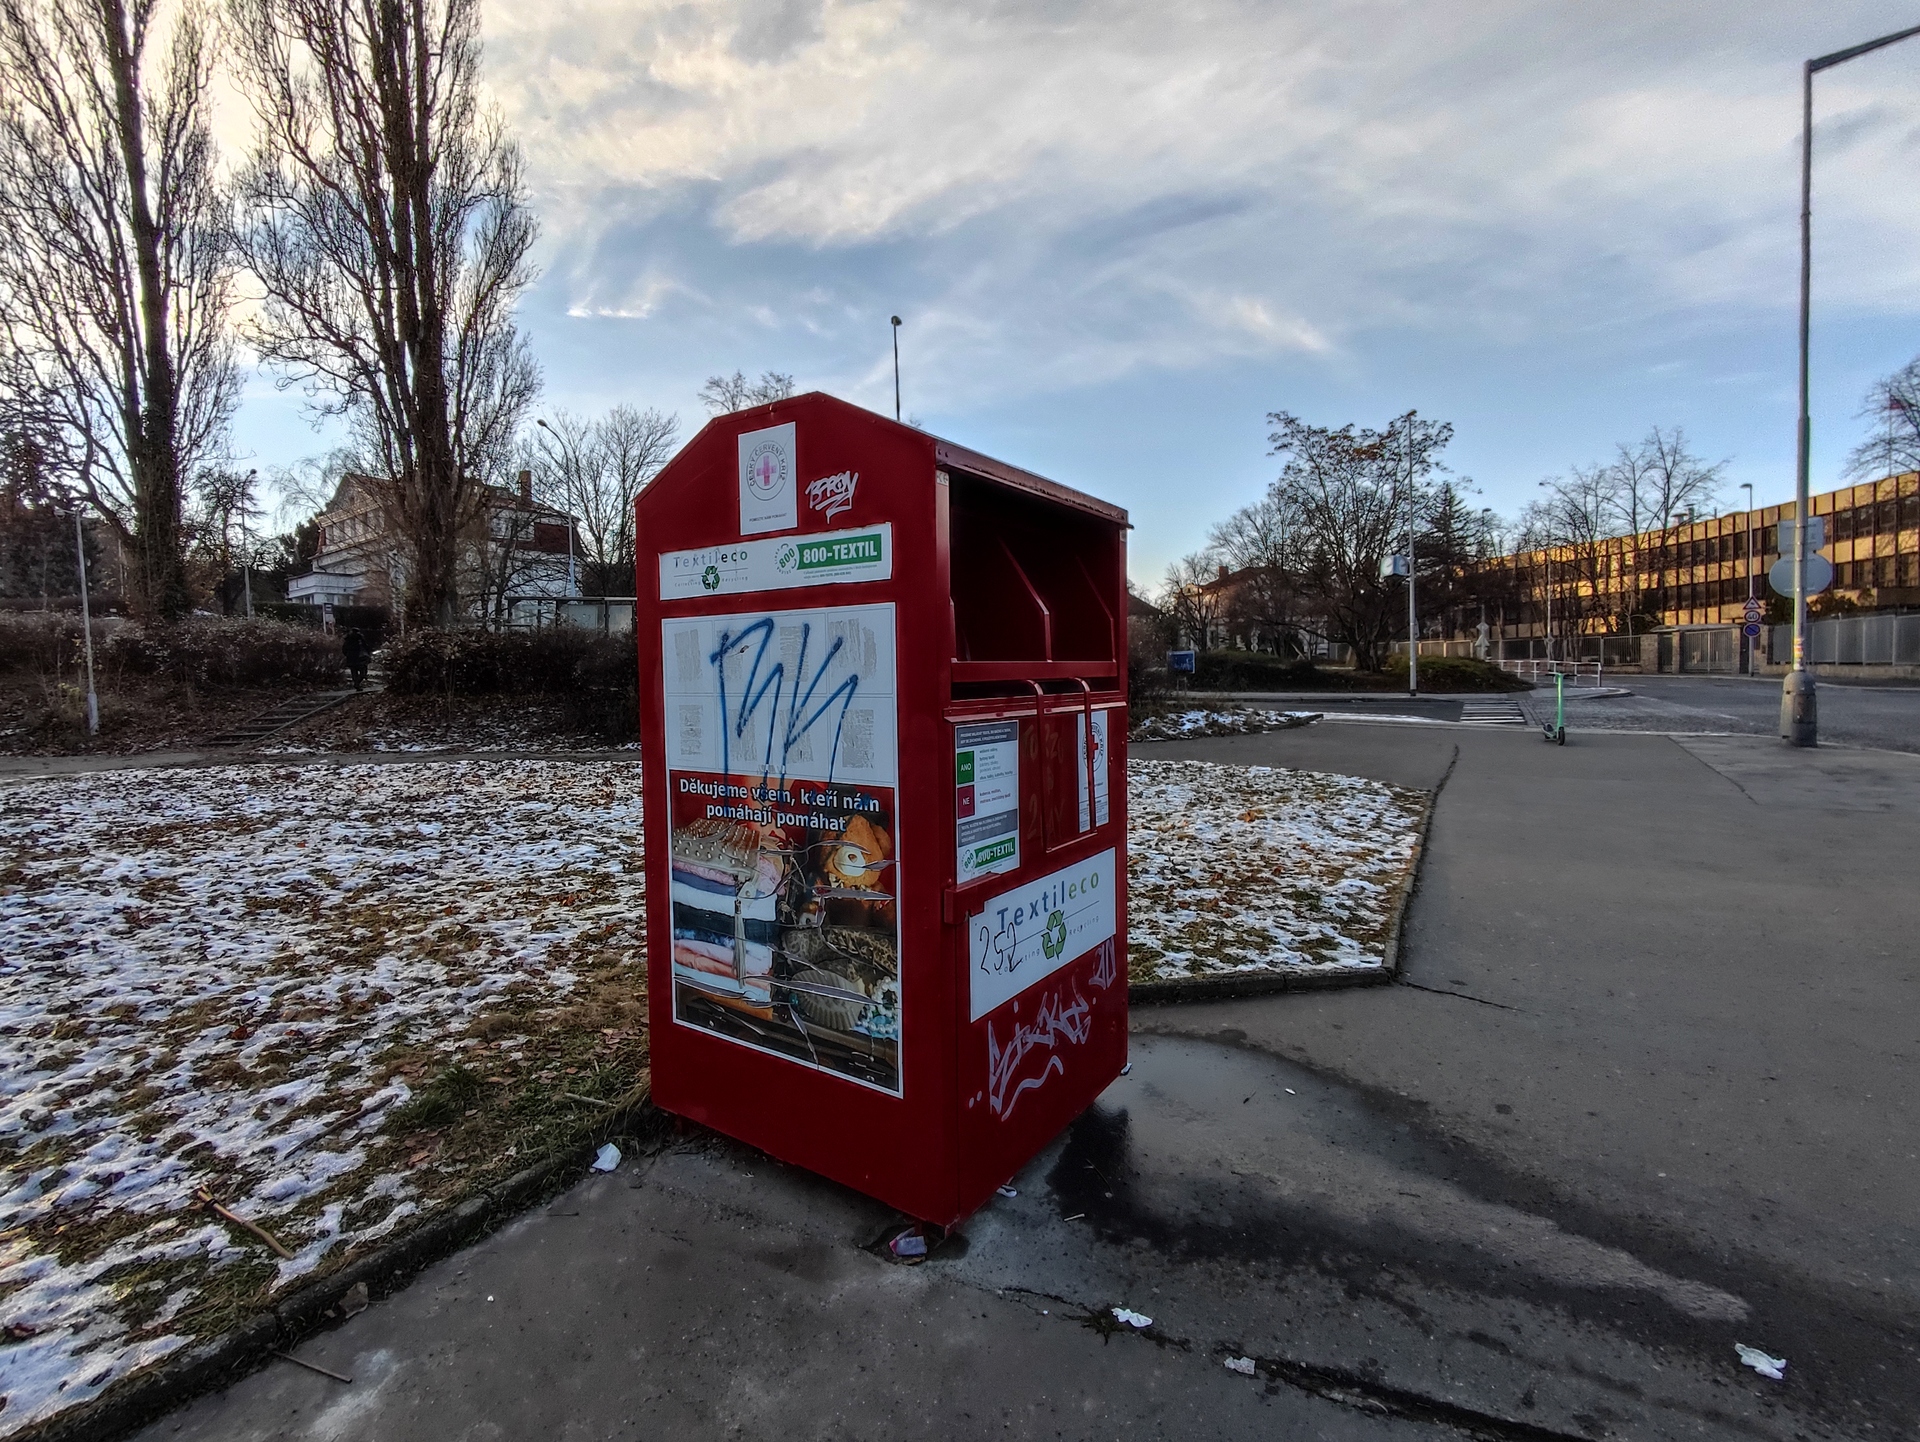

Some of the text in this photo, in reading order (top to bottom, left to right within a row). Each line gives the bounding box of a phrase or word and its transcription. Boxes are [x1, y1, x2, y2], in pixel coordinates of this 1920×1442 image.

[674, 550, 748, 568] Textileco
[779, 547, 796, 569] 800
[803, 540, 878, 564] 800-TEXTIL
[960, 762, 972, 772] ANO
[680, 778, 880, 812] Děkujeme všem, kteří nám
[962, 797, 970, 806] NE
[707, 804, 846, 832] pomáhají pomáhat
[997, 872, 1099, 931] Textileco
[979, 921, 1023, 975] 252
